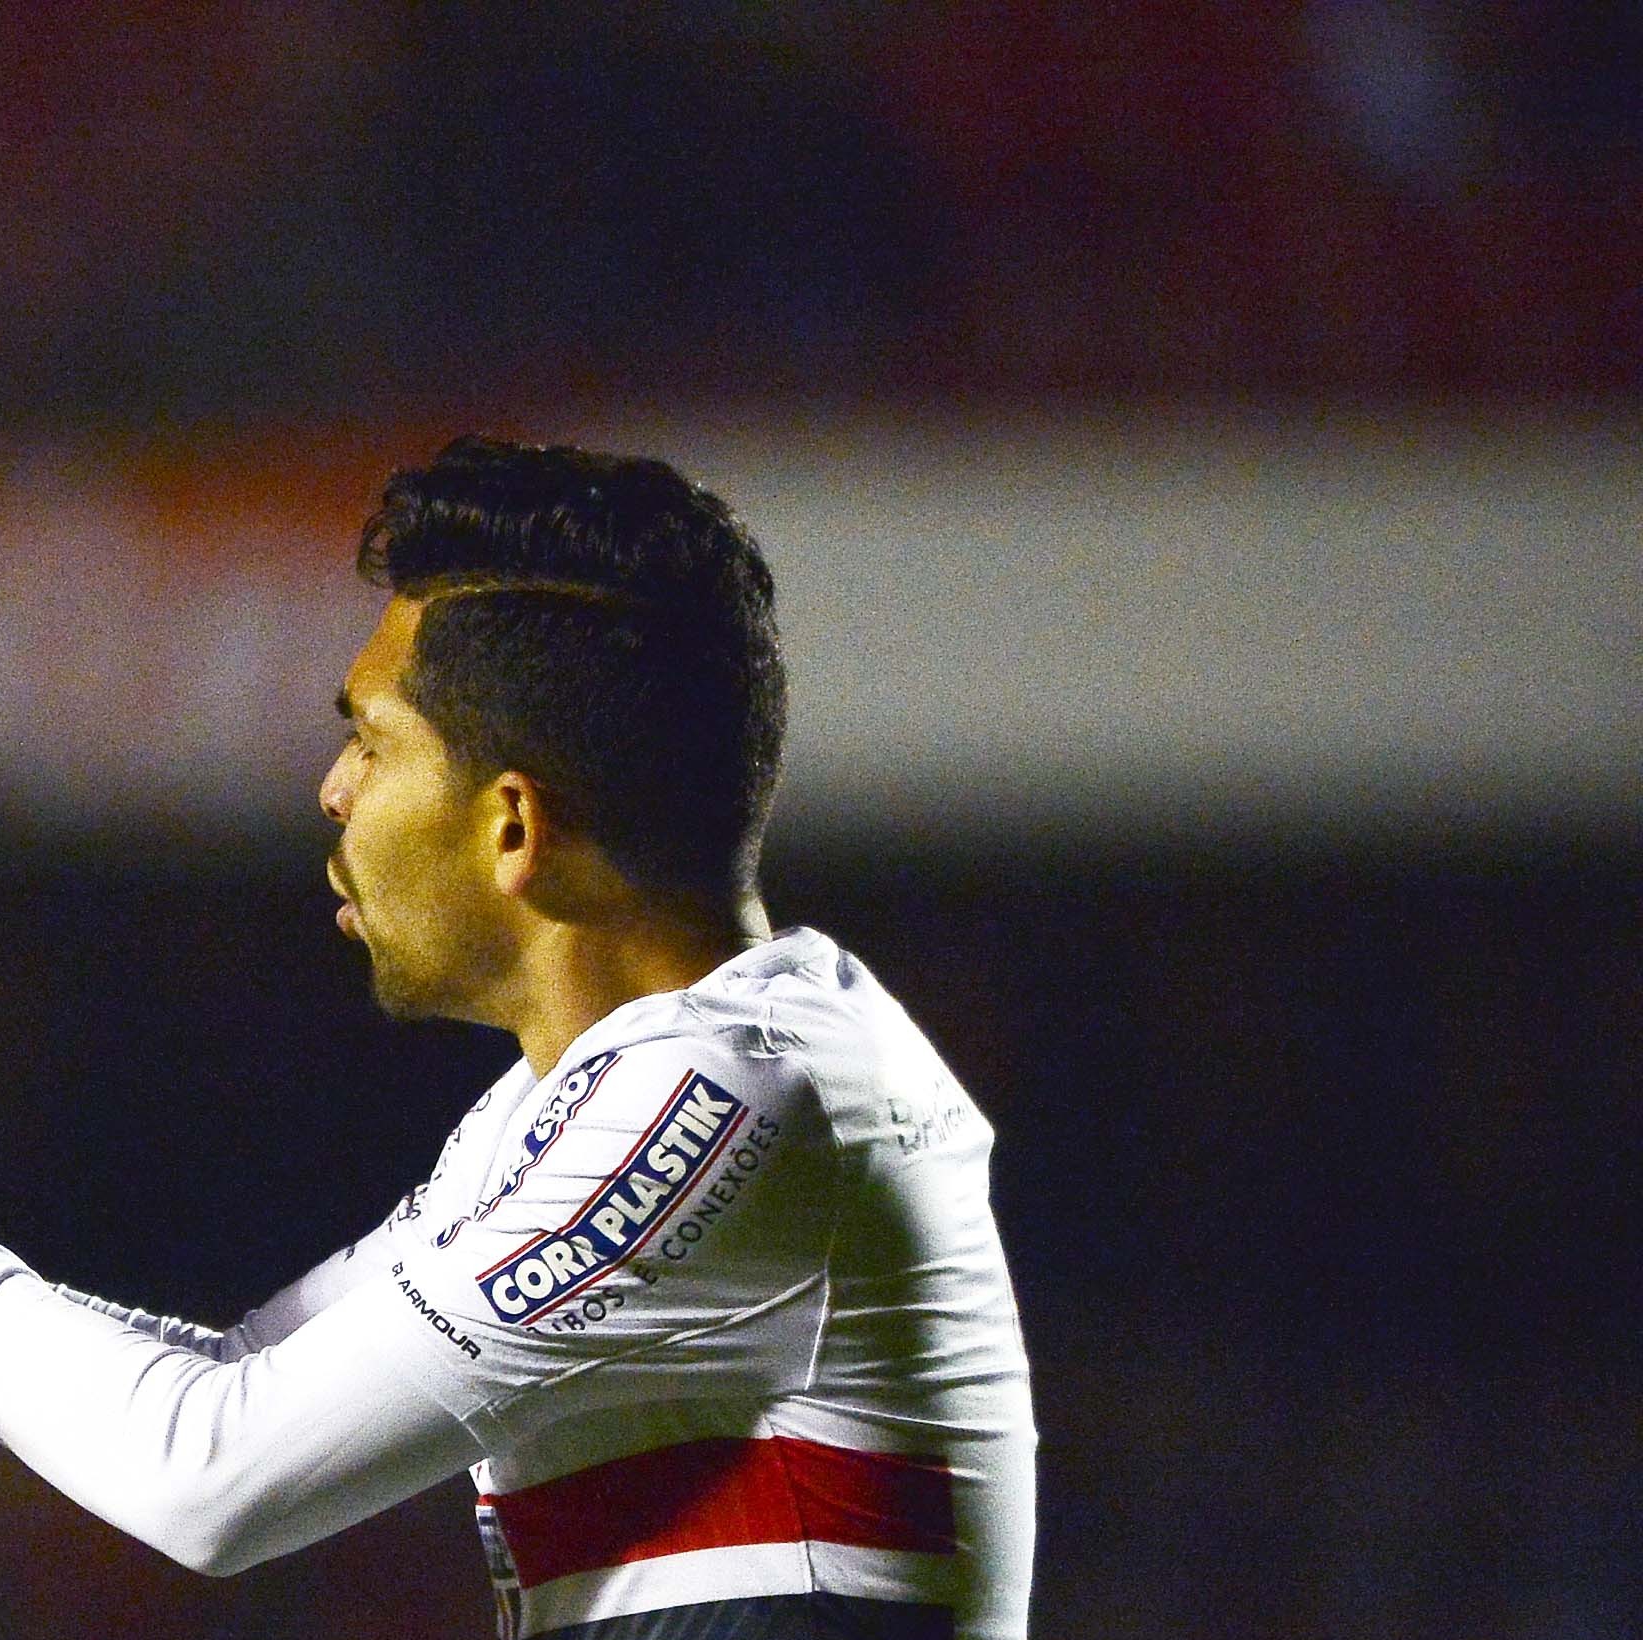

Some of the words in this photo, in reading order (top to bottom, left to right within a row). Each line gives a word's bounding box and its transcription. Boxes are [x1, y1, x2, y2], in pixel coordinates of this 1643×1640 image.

[492, 1235, 607, 1315] CORR
[591, 1083, 733, 1246] PLASTIK
[398, 1278, 482, 1360] ARMOUR
